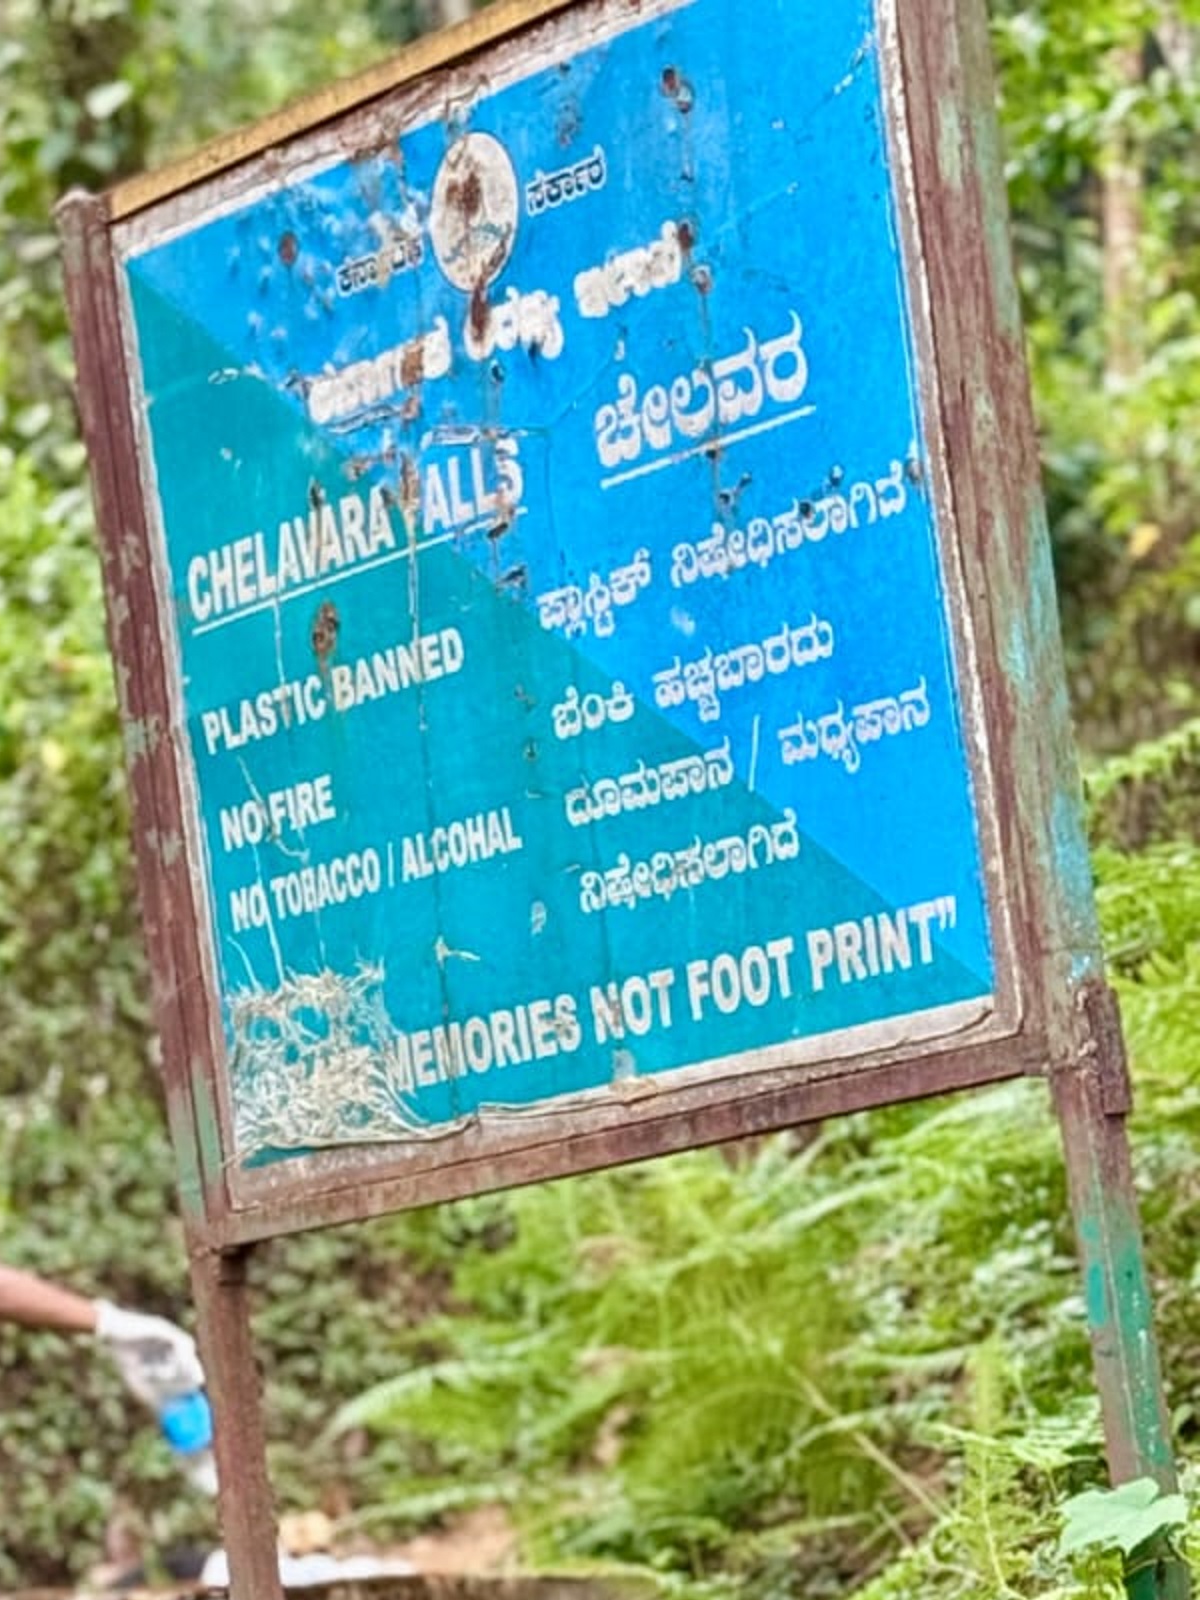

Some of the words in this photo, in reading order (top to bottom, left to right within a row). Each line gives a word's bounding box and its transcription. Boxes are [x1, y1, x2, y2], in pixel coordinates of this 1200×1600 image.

[594, 312, 808, 467] ಚೇಲವರ
[187, 487, 395, 621] CHELAVARA
[405, 433, 522, 524] ALLS
[202, 677, 325, 754] PLASTIC
[329, 629, 463, 710] BANNED
[553, 683, 634, 739] ಬೆಂಕಿ
[221, 796, 264, 851] NO
[268, 775, 335, 837] FIRE
[230, 882, 268, 931] NO
[272, 849, 379, 918] TOBACCO
[402, 810, 522, 880] ALCOHAL
[388, 995, 581, 1092] MEMORIES
[590, 969, 675, 1043] NOT
[687, 937, 794, 1020] FOOT
